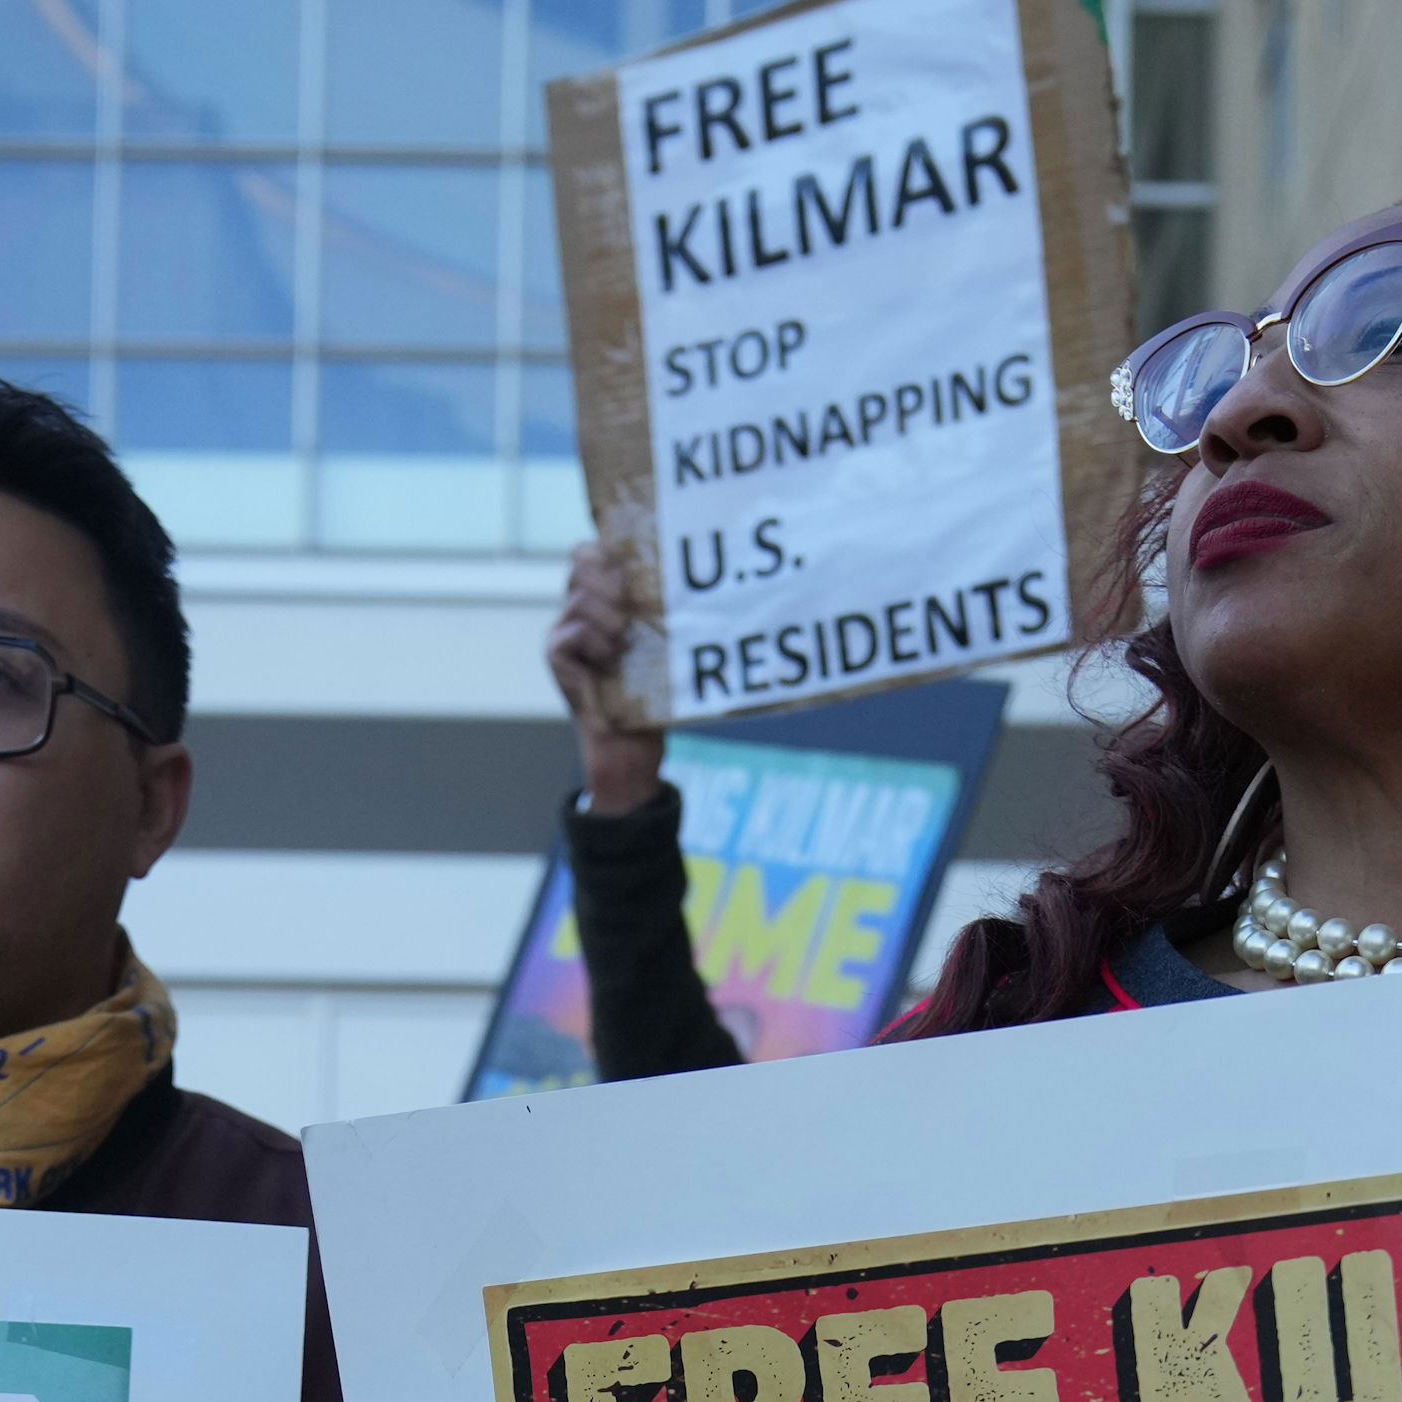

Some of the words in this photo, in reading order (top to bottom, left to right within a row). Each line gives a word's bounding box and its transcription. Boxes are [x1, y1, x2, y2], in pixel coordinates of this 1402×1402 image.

[643, 38, 861, 175] FREE
[654, 114, 1021, 292] KILMAR
[663, 320, 809, 397] STOP
[672, 354, 1035, 487] KIDNAPPING
[679, 519, 804, 592] U.S.
[689, 571, 1051, 702] RESIDENTS
